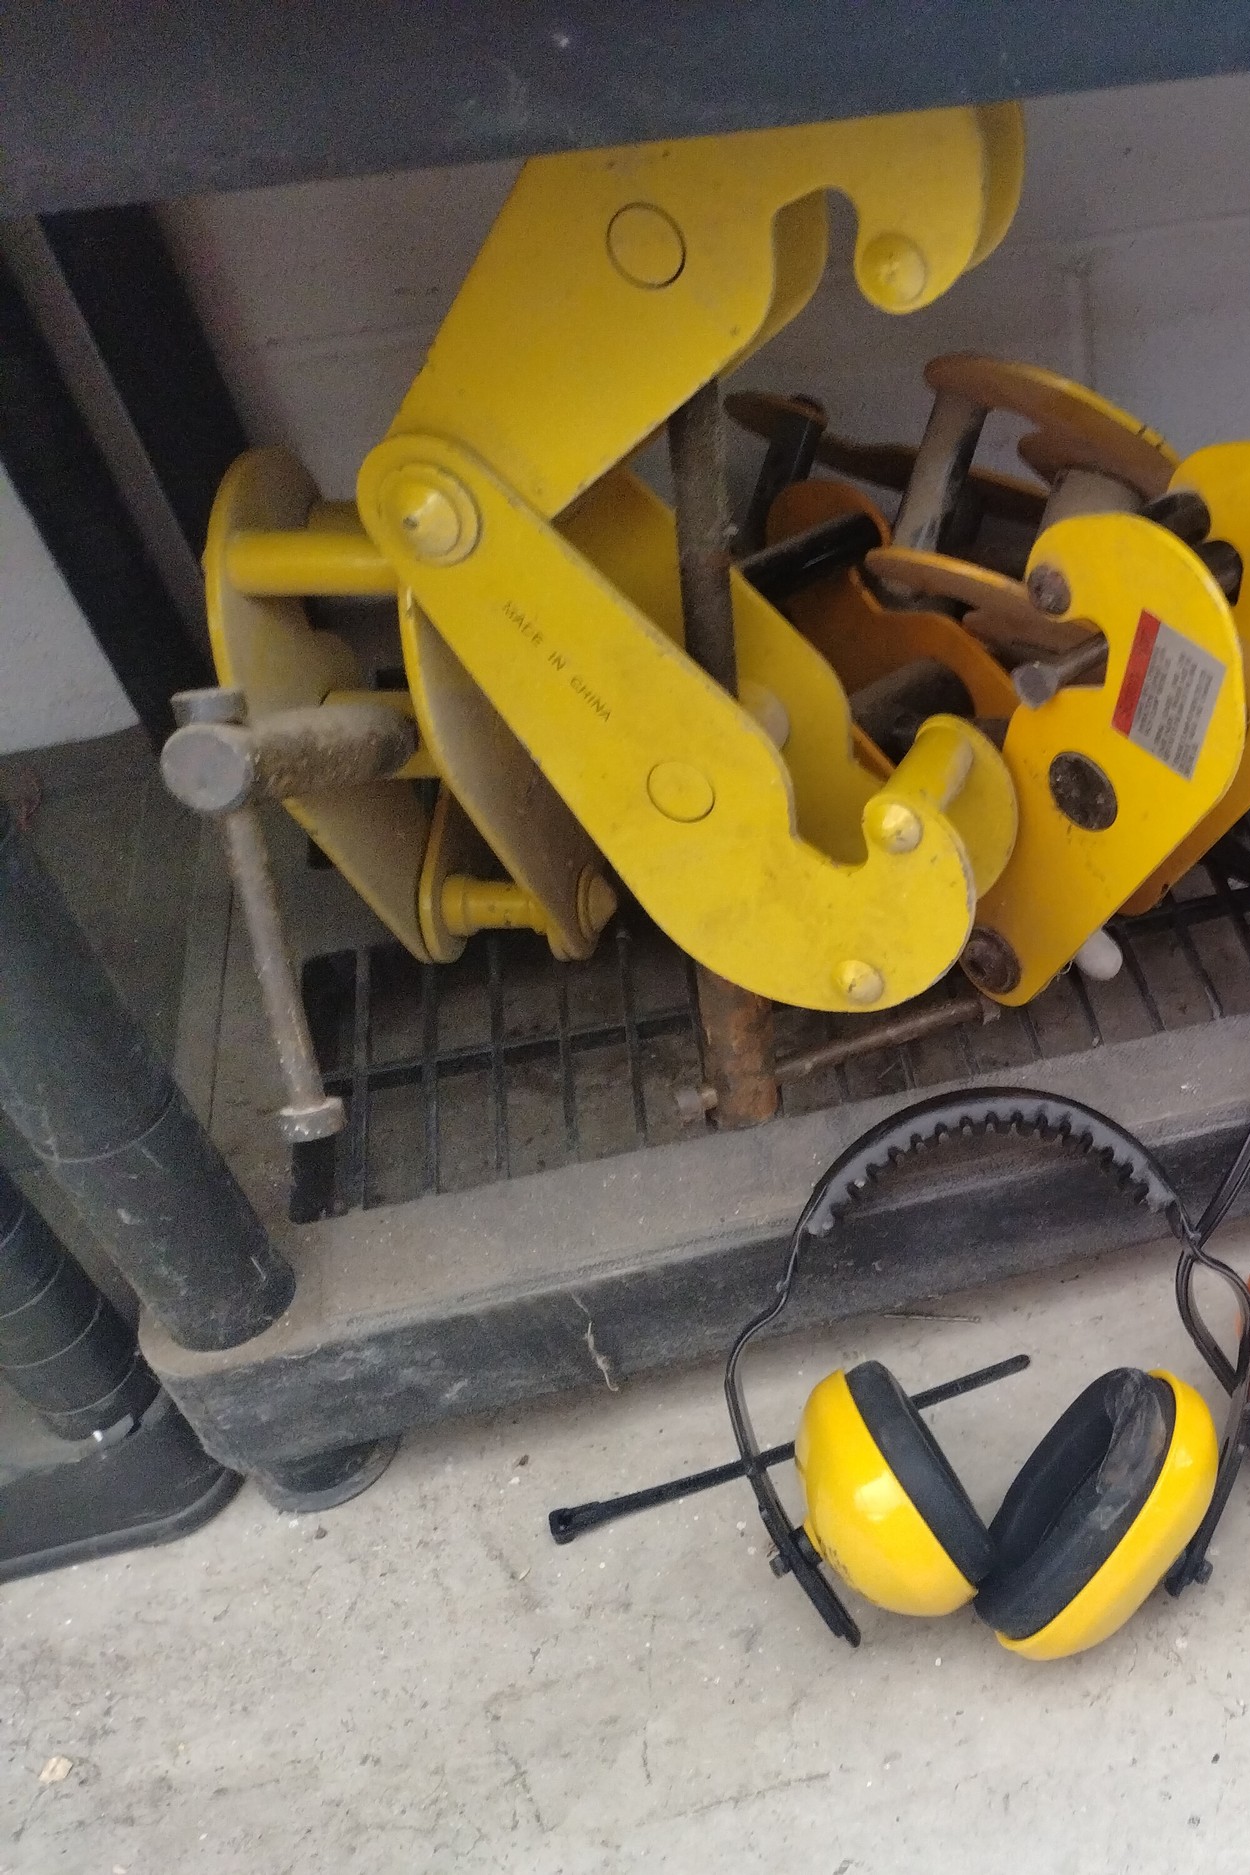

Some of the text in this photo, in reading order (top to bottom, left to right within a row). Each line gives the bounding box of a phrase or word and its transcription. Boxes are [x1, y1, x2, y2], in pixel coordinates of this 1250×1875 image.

[502, 600, 612, 722] MADE IN CHINA
